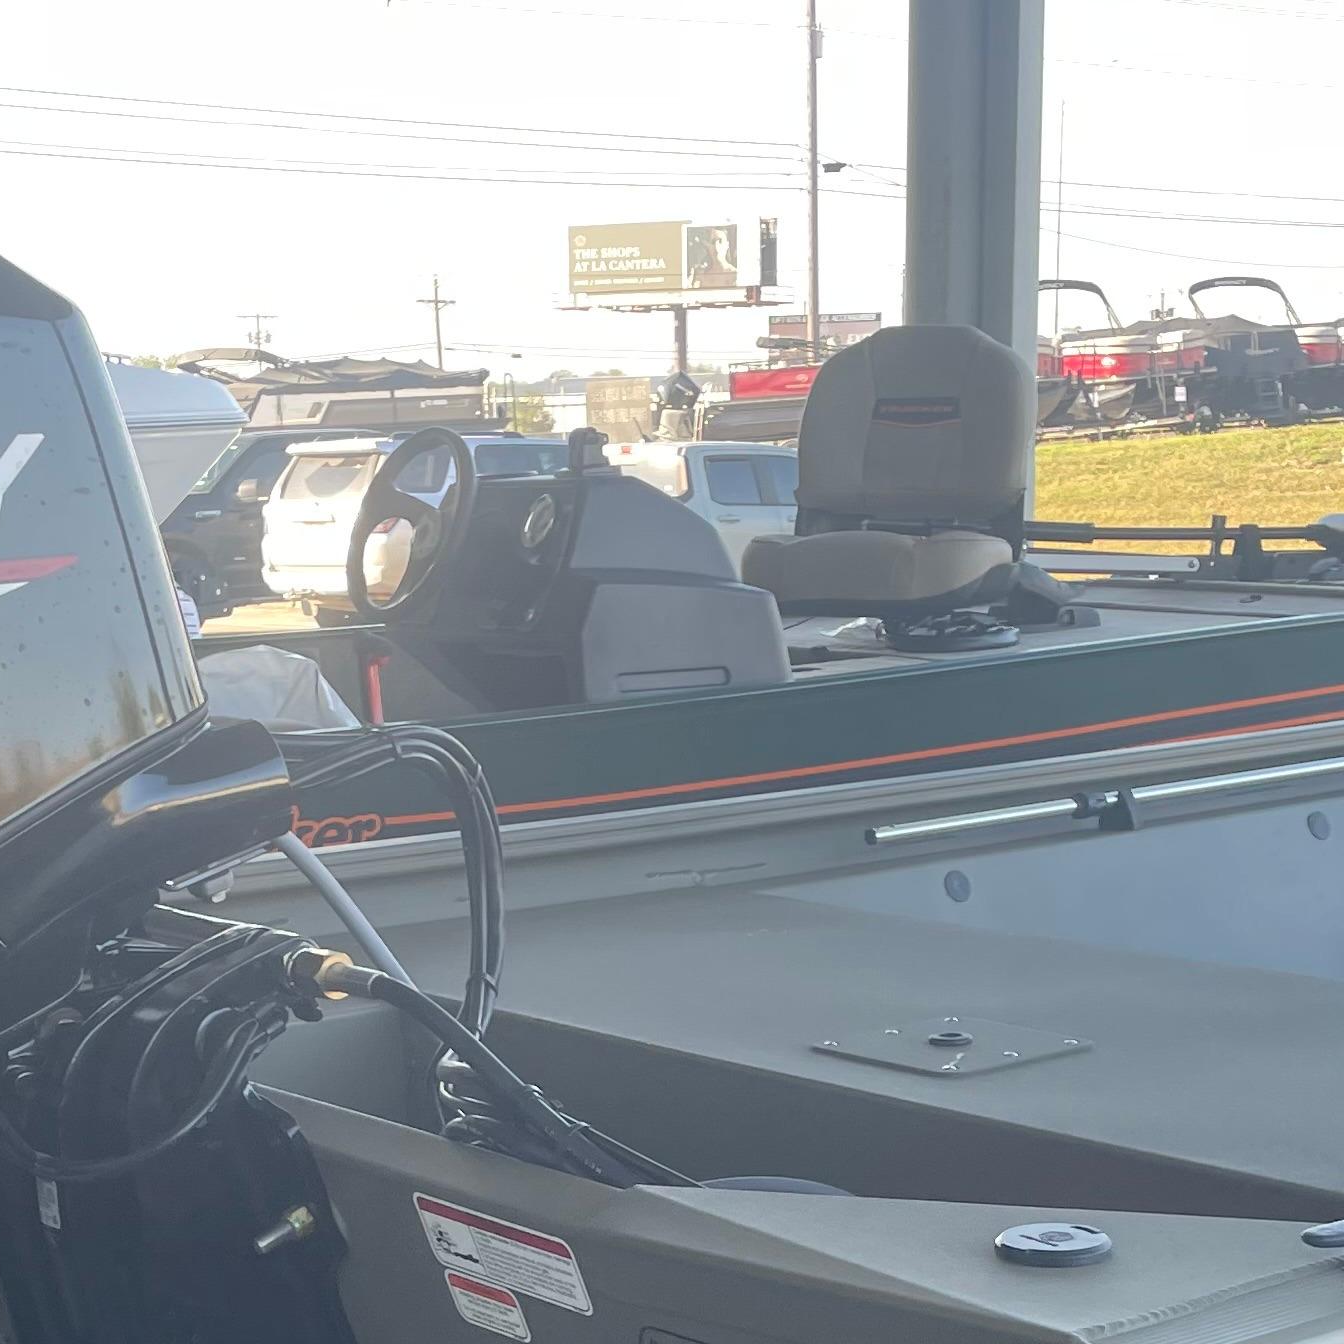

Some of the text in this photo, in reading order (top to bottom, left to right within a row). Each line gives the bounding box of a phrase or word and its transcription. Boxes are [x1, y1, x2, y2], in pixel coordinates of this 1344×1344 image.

[573, 246, 641, 259] THE SHOPS
[574, 258, 666, 272] AT LA CANTERA
